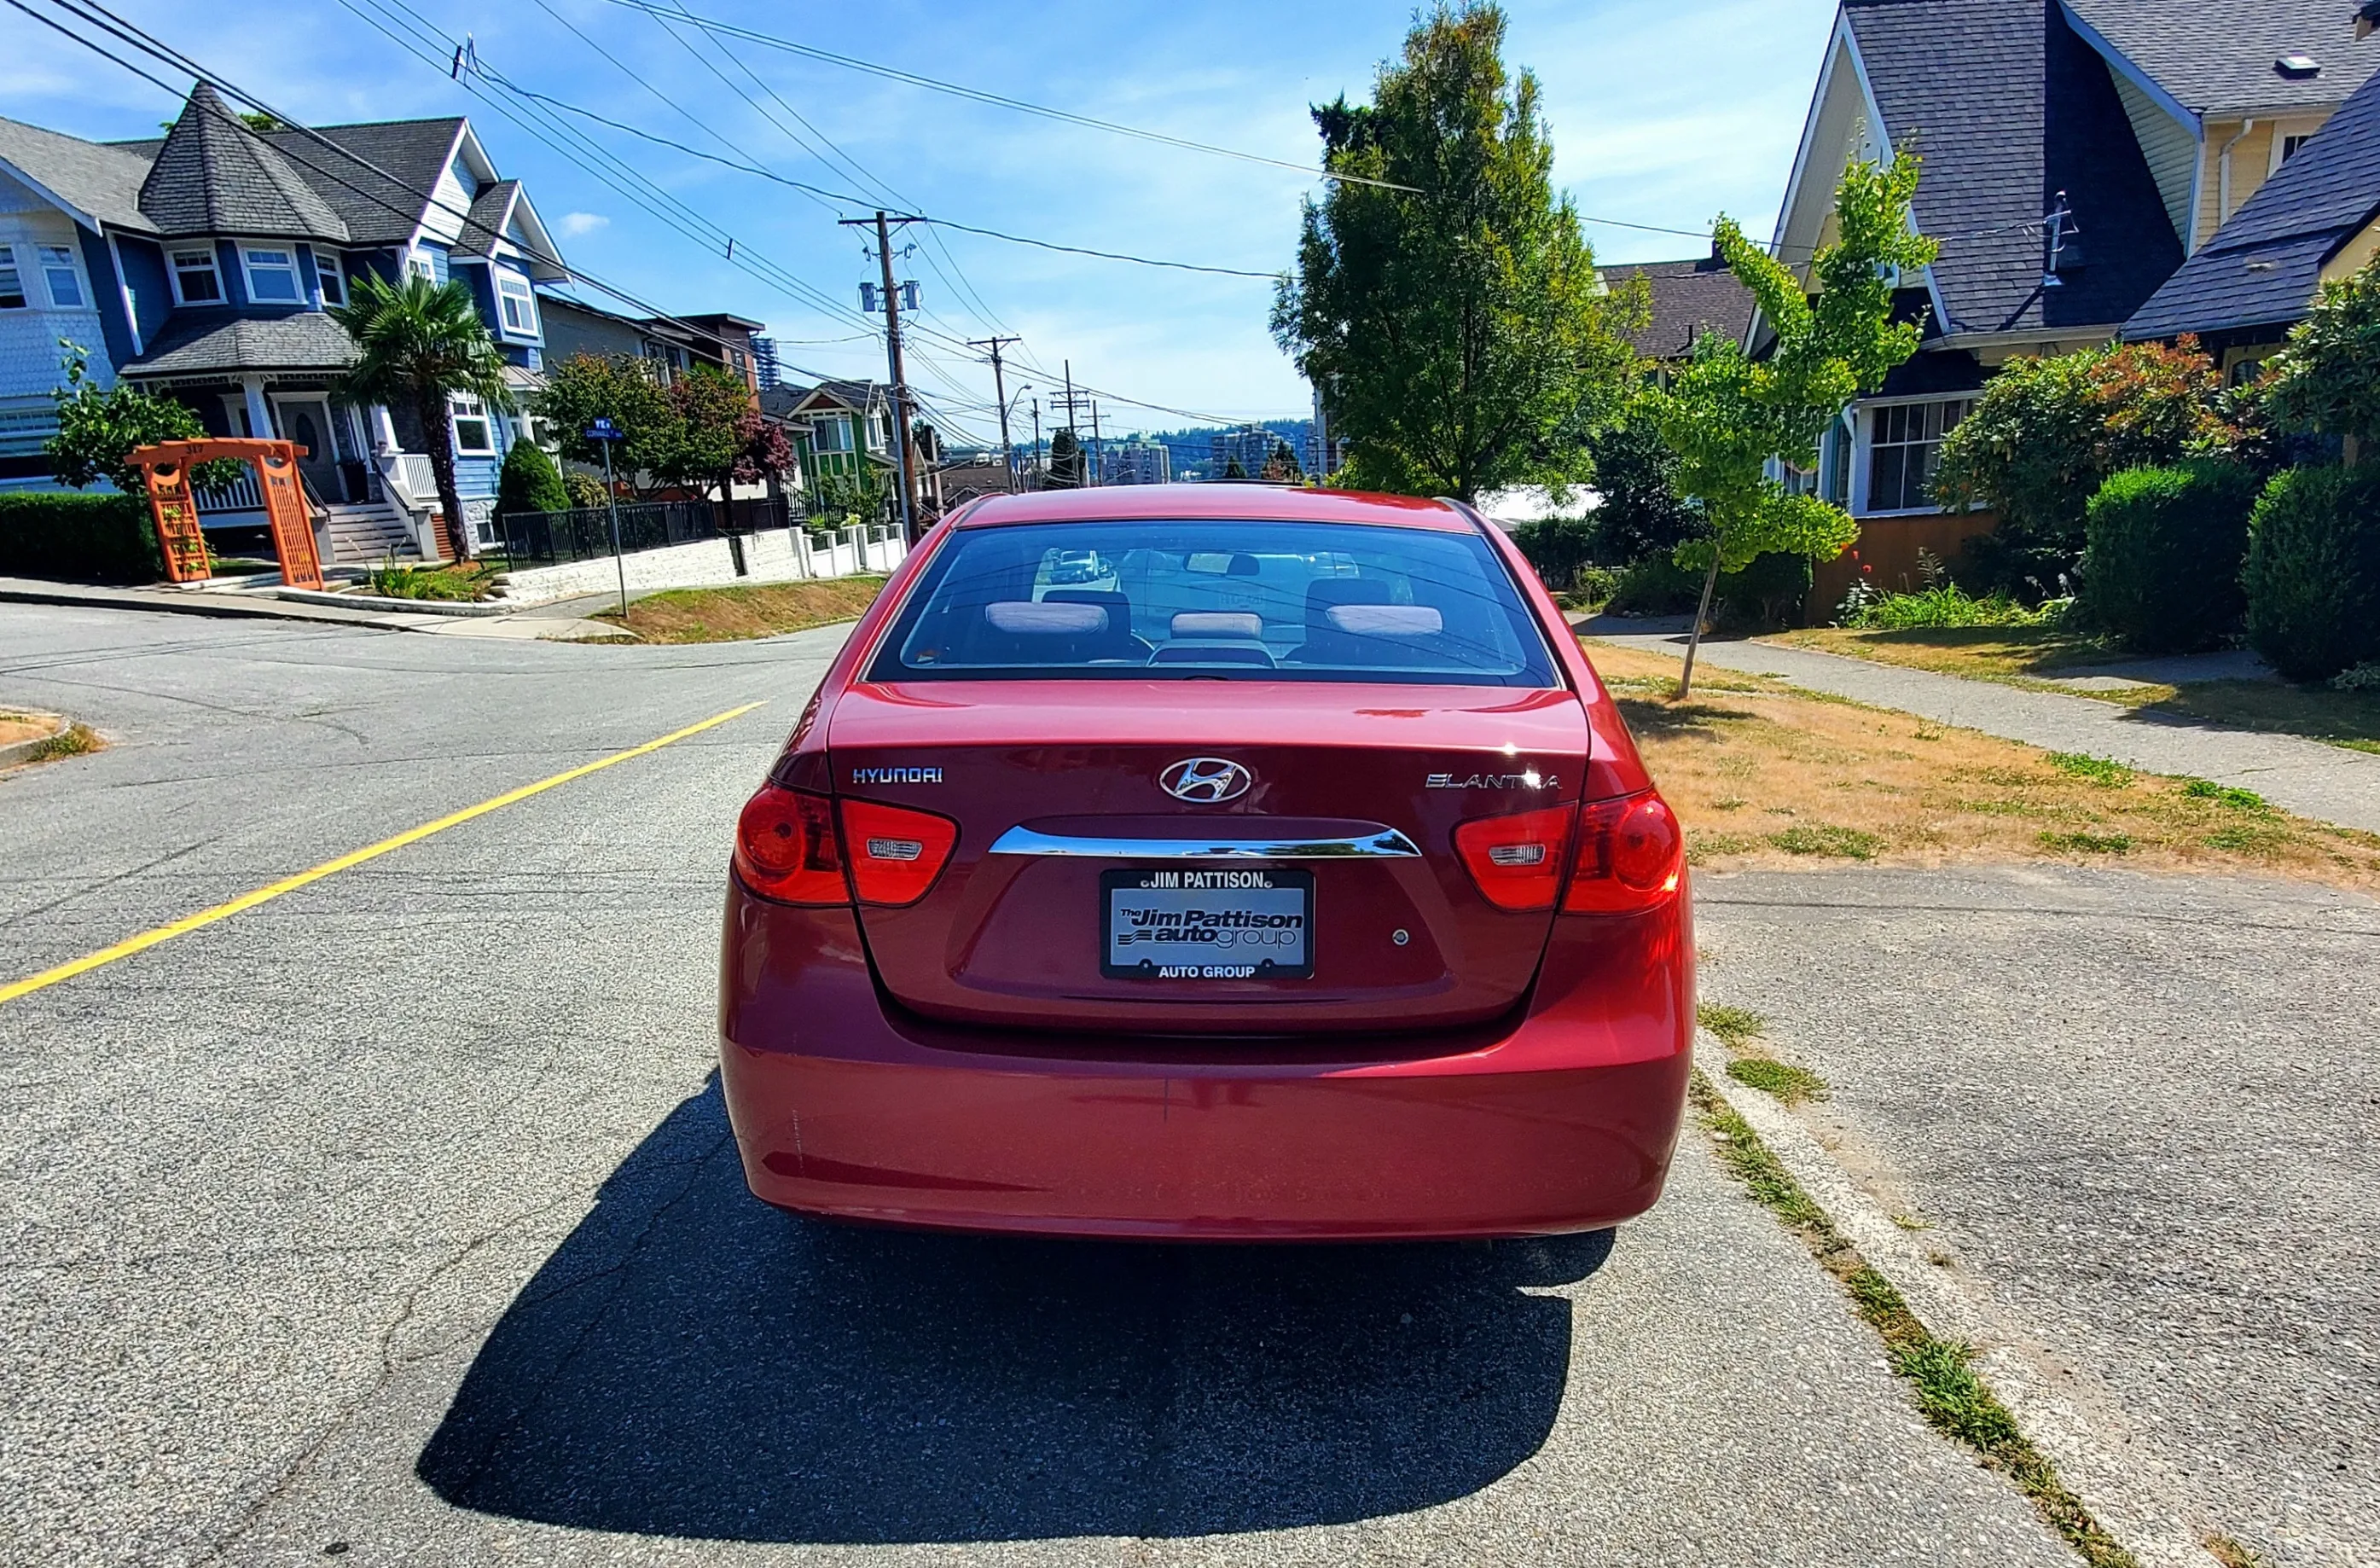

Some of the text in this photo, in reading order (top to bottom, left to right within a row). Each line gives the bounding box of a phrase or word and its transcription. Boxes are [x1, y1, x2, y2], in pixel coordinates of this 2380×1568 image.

[853, 768, 943, 783] HYUNDAI
[1151, 872, 1264, 888] JIM PATTISON
[1121, 909, 1303, 928] The Jim Pattison
[1158, 966, 1256, 979] AUTO GROUP
